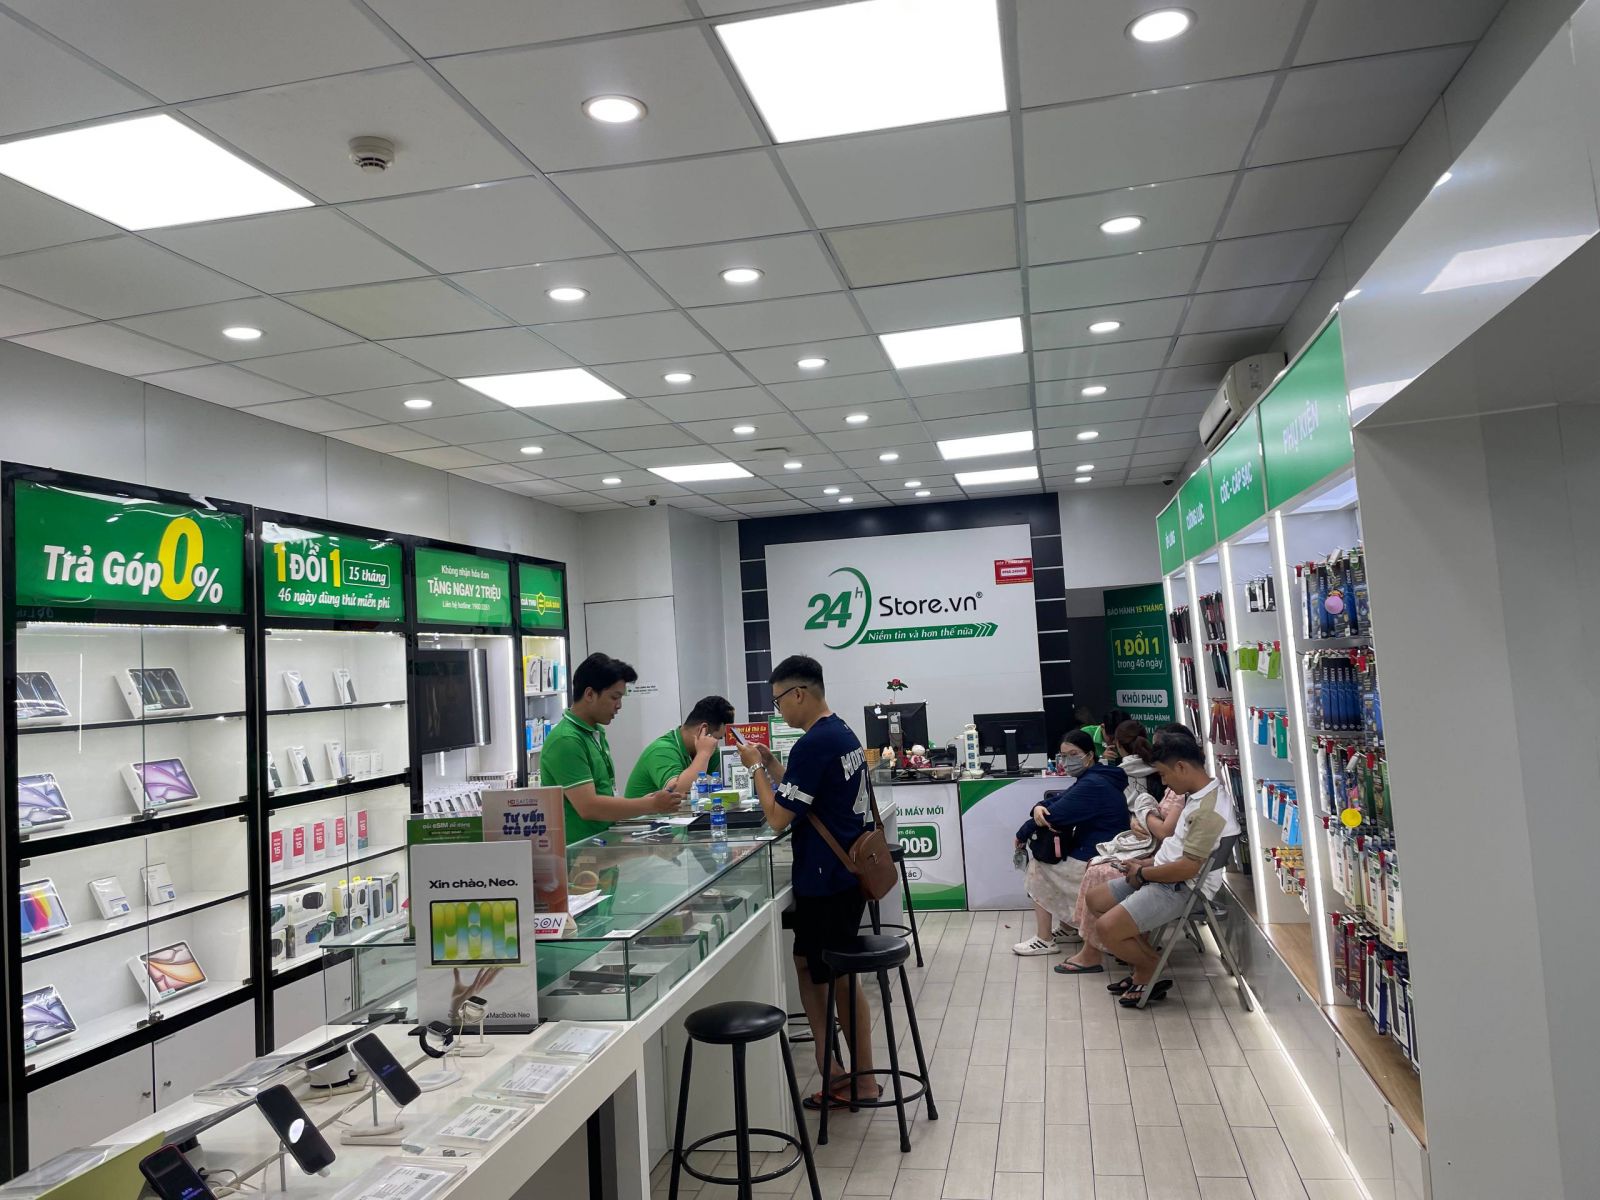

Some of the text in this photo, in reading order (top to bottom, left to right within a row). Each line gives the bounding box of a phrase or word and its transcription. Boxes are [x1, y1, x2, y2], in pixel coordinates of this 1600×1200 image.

[44, 545, 94, 583] Trả
[103, 551, 162, 596] Góp
[273, 542, 341, 588] 1 ĐỔI 1
[348, 566, 387, 586] 15 tháng
[427, 577, 452, 597] TẶNG
[453, 582, 475, 597] NGAY
[475, 584, 481, 598] 2
[481, 584, 501, 602] TRIỆU
[278, 587, 390, 610] 46 ngày dùng thử miễn phí
[894, 630, 906, 640] tin
[909, 630, 919, 639] và
[921, 628, 938, 638] hơn
[940, 626, 957, 636] thế
[957, 627, 973, 635] nữa
[1115, 630, 1160, 656] 1 ĐỔI 1
[1117, 658, 1163, 670] trong 46 ngày
[1141, 694, 1163, 706] PHỤC
[503, 809, 545, 823] Tư vấn
[905, 806, 924, 816] MÁY
[926, 805, 944, 815] MỚI
[502, 821, 547, 837] trả góp
[899, 837, 933, 854] 00Đ
[429, 878, 518, 889] Xin chào, Neo.
